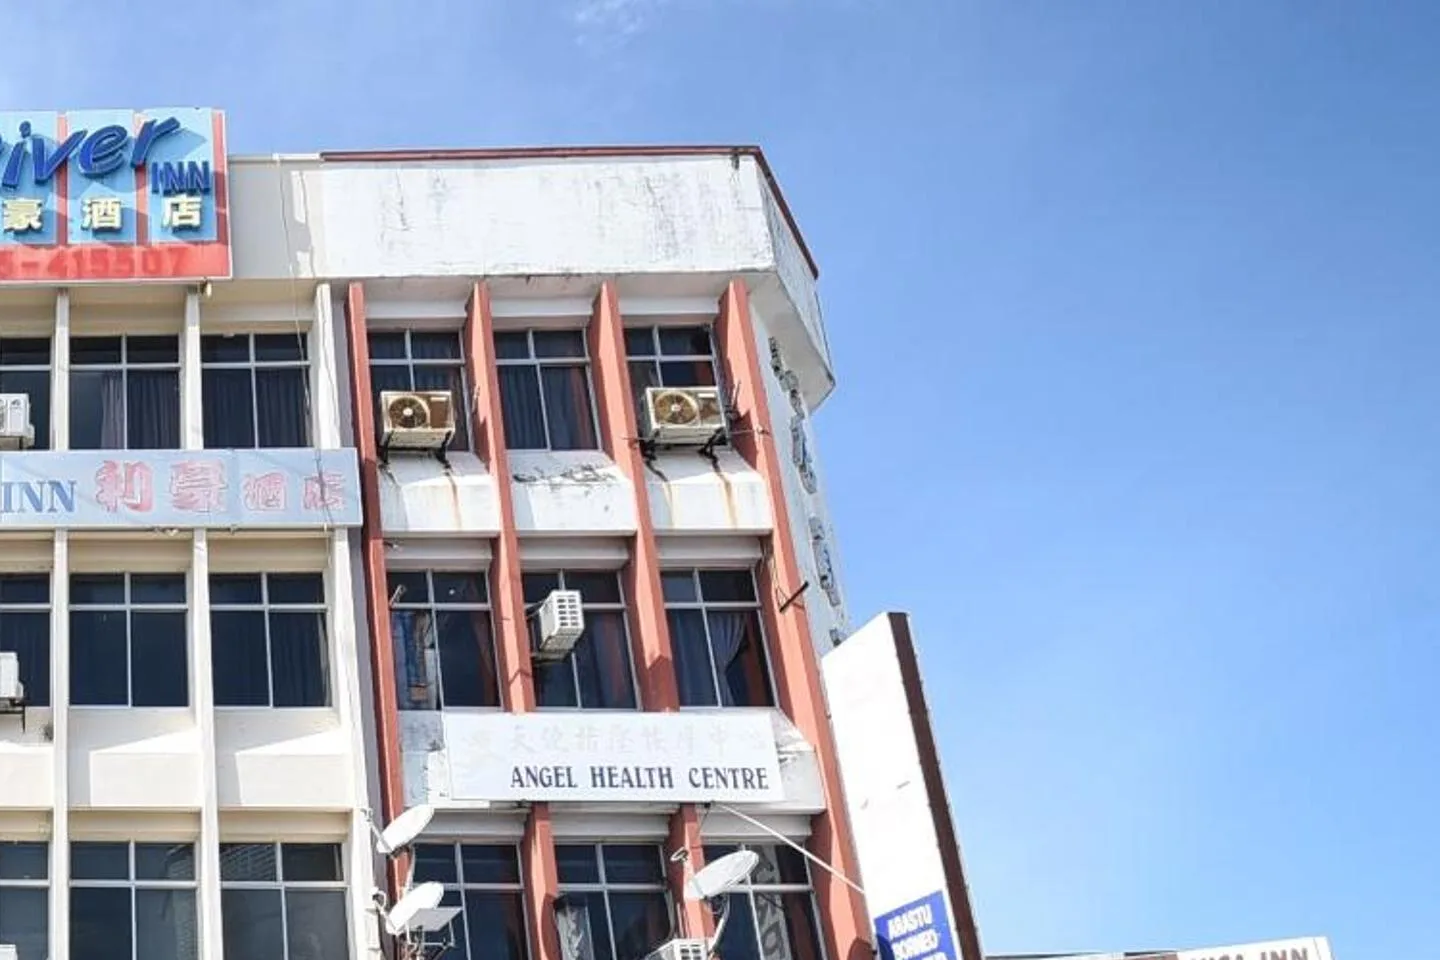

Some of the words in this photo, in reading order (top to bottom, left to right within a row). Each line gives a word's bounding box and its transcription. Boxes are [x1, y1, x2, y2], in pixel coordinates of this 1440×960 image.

[150, 160, 213, 195] INN
[0, 478, 78, 515] INN
[510, 766, 577, 789] ANGEL
[590, 766, 675, 789] HEALTH
[688, 767, 769, 789] CENTRE
